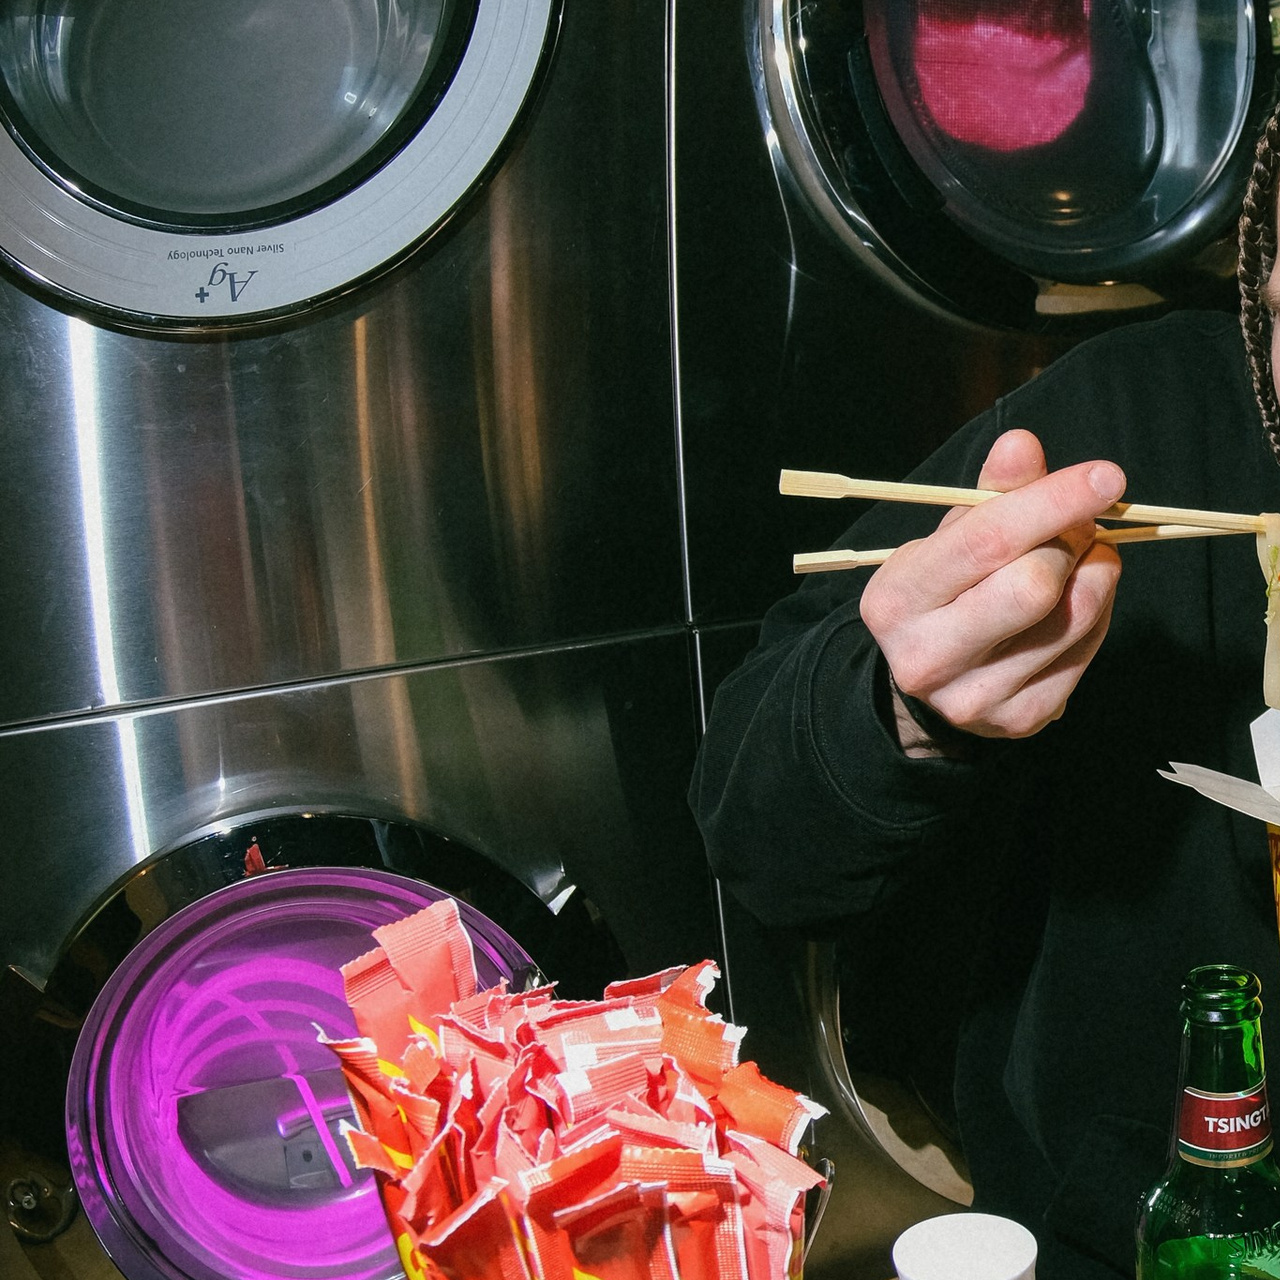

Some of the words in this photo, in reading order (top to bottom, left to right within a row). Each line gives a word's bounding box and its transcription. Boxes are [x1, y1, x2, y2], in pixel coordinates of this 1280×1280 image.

[227, 246, 253, 256] Nano
[258, 244, 284, 254] Silver
[167, 248, 224, 261] Technology
